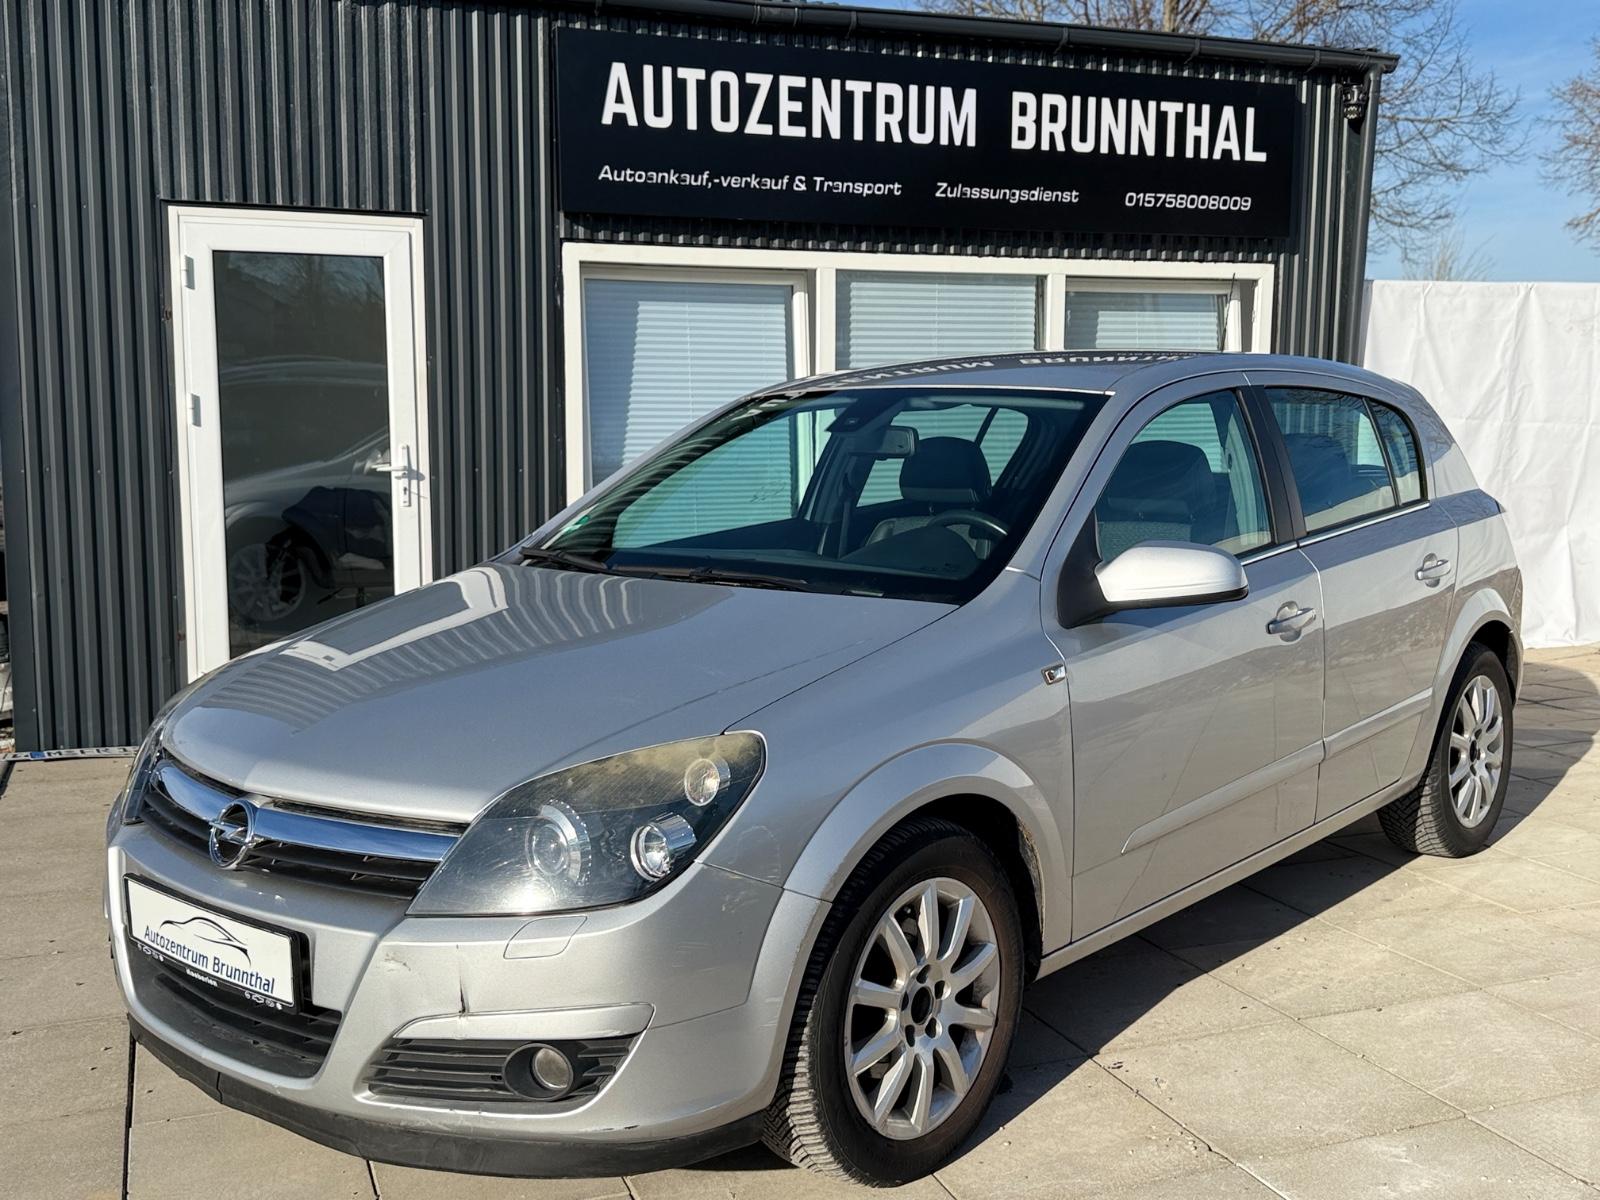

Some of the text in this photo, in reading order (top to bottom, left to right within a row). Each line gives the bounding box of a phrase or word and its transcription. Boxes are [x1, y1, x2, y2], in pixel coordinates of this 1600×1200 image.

[601, 62, 1267, 162] AUTOZENTRUM BRUNNTHAL
[792, 176, 807, 191] &
[813, 177, 903, 198] Transport
[935, 182, 1080, 204] Zulassungsdienst
[1124, 192, 1252, 211] 015758008009
[144, 925, 209, 969] Autozentrum
[212, 956, 275, 995] Brunnthal
